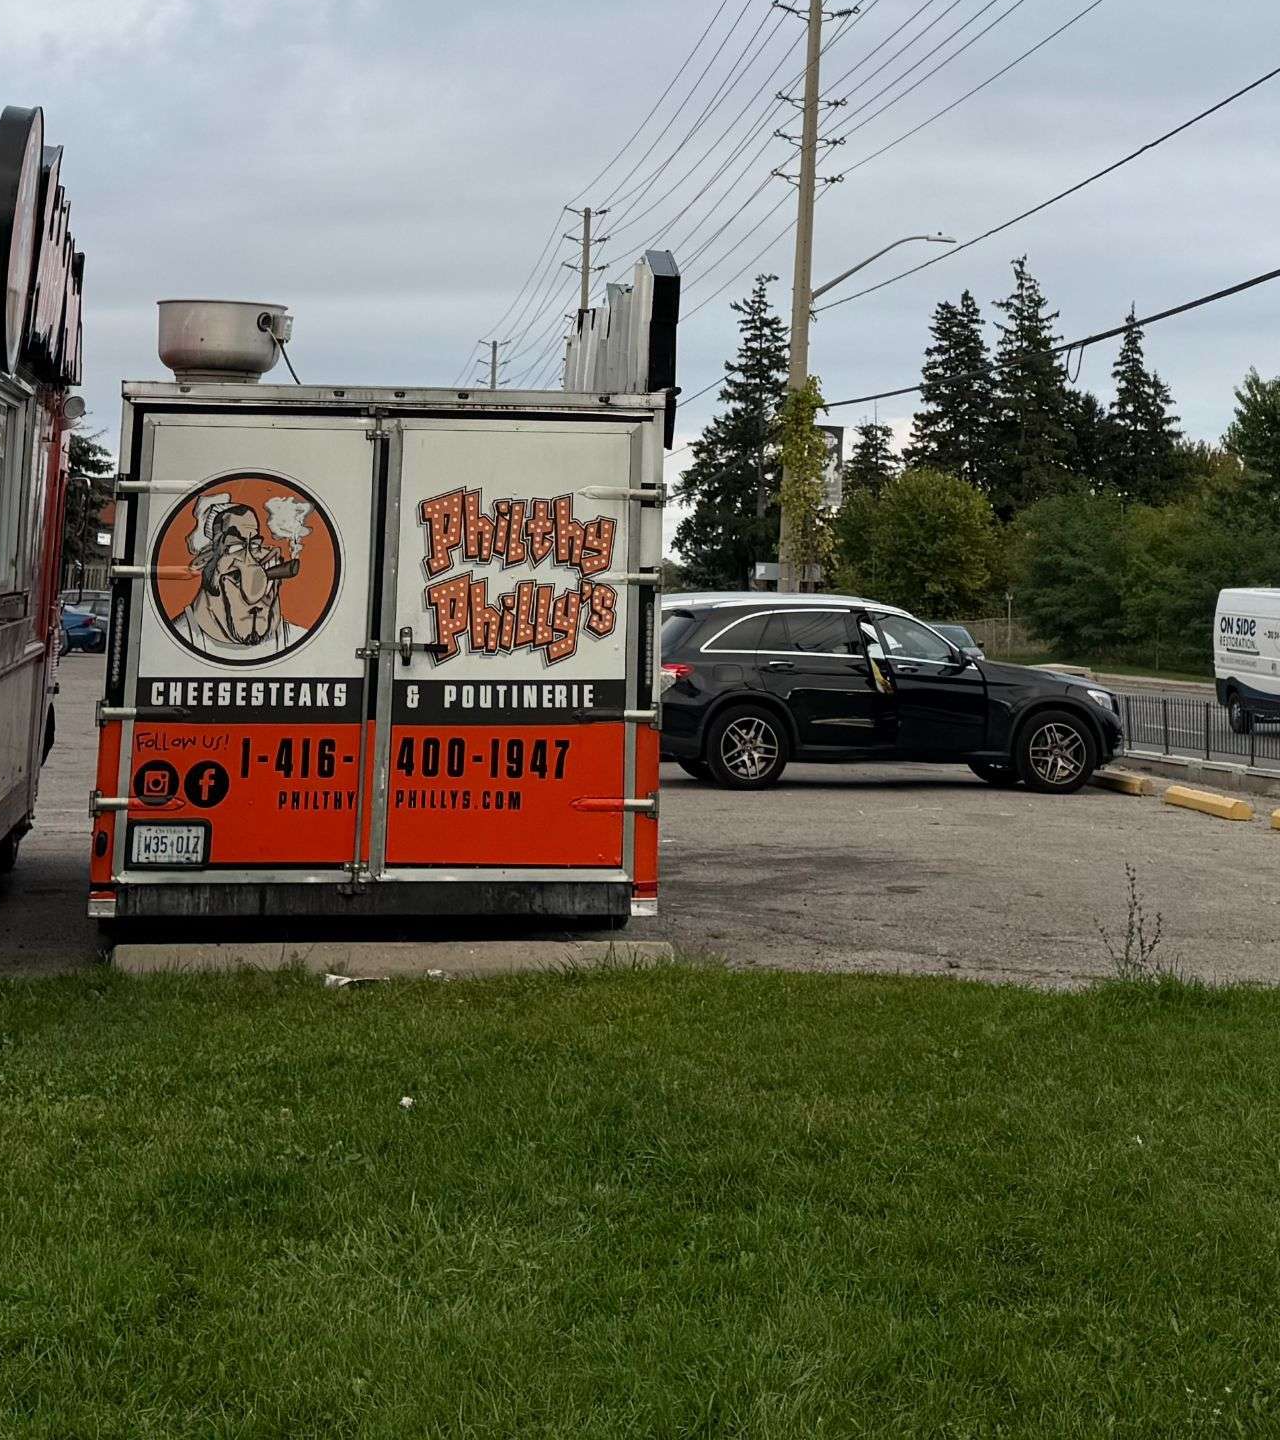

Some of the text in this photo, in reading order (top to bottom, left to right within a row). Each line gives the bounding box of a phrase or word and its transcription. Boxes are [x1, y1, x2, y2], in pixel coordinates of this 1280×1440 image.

[419, 486, 617, 577] Philthy
[424, 570, 617, 667] Philly's
[1220, 616, 1233, 634] ON
[151, 681, 594, 709] CHEESESTEAKS & POUTINERIE
[396, 736, 570, 779] 400-1947
[278, 790, 521, 810] PHILTHY PHILLYS.COM
